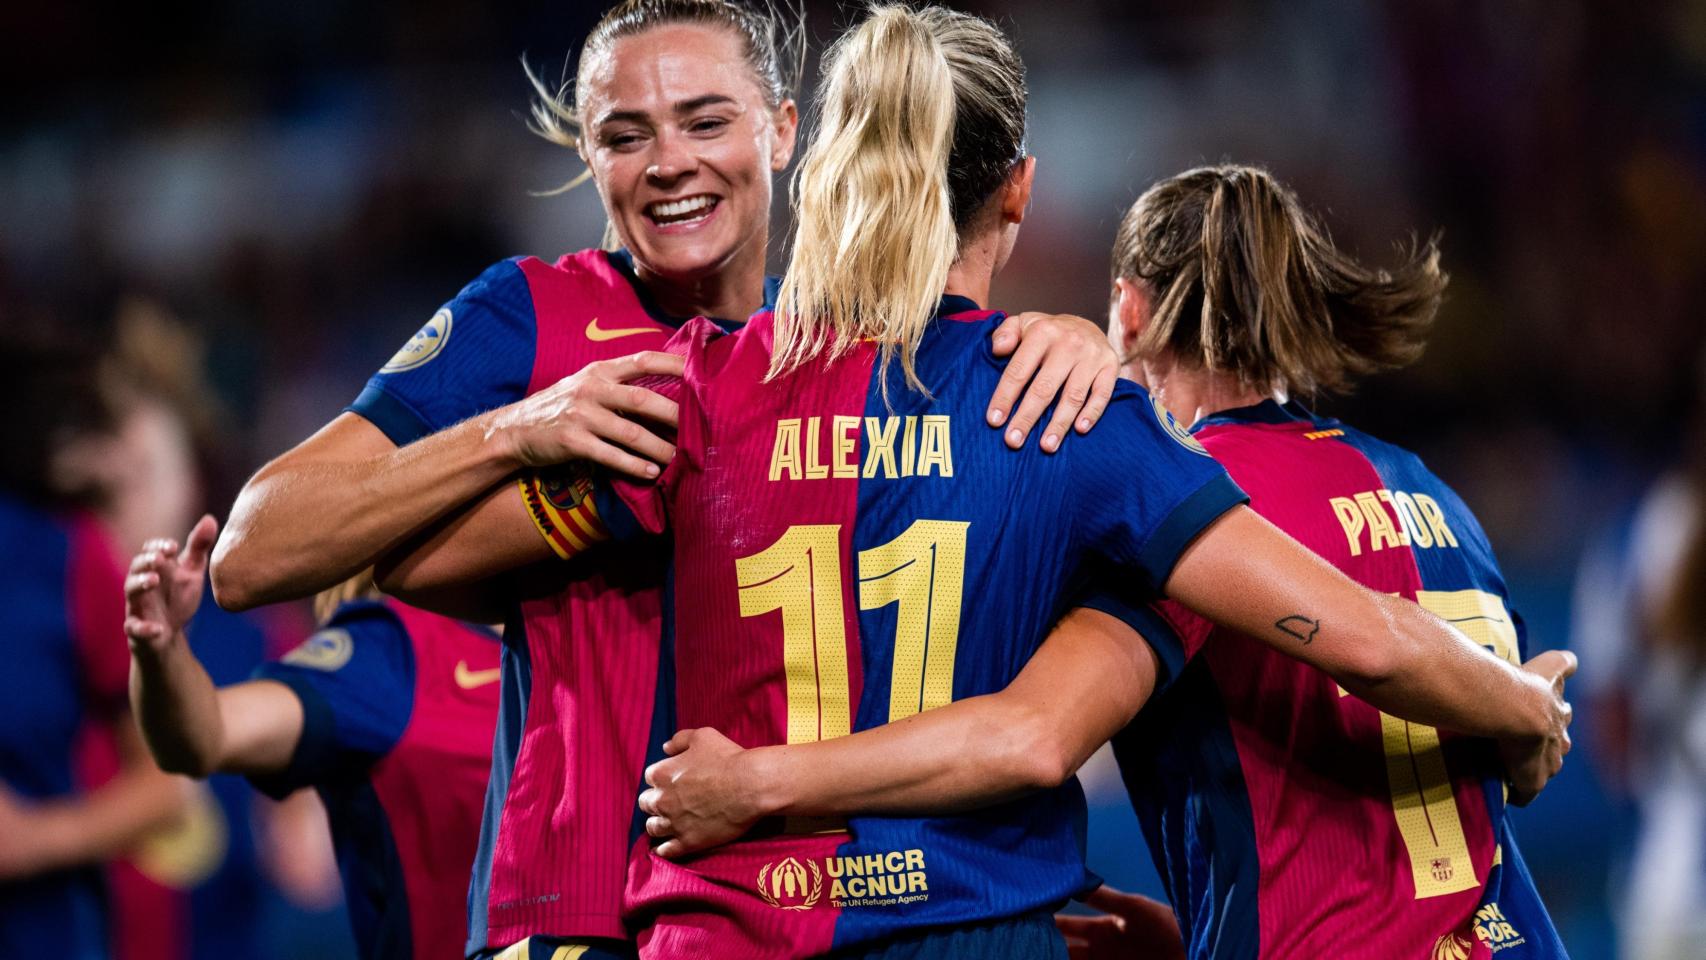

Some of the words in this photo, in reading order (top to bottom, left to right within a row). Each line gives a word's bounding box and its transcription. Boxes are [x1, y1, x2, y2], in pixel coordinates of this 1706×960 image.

[768, 415, 953, 481] ALEXIA
[1329, 489, 1459, 557] PAJOR
[735, 519, 971, 746] 11
[825, 849, 926, 878] UNHCR
[829, 872, 928, 899] ACNUR
[831, 900, 847, 908] The
[848, 899, 861, 907] UN
[862, 898, 897, 907] Refugee
[897, 894, 929, 905] Agency
